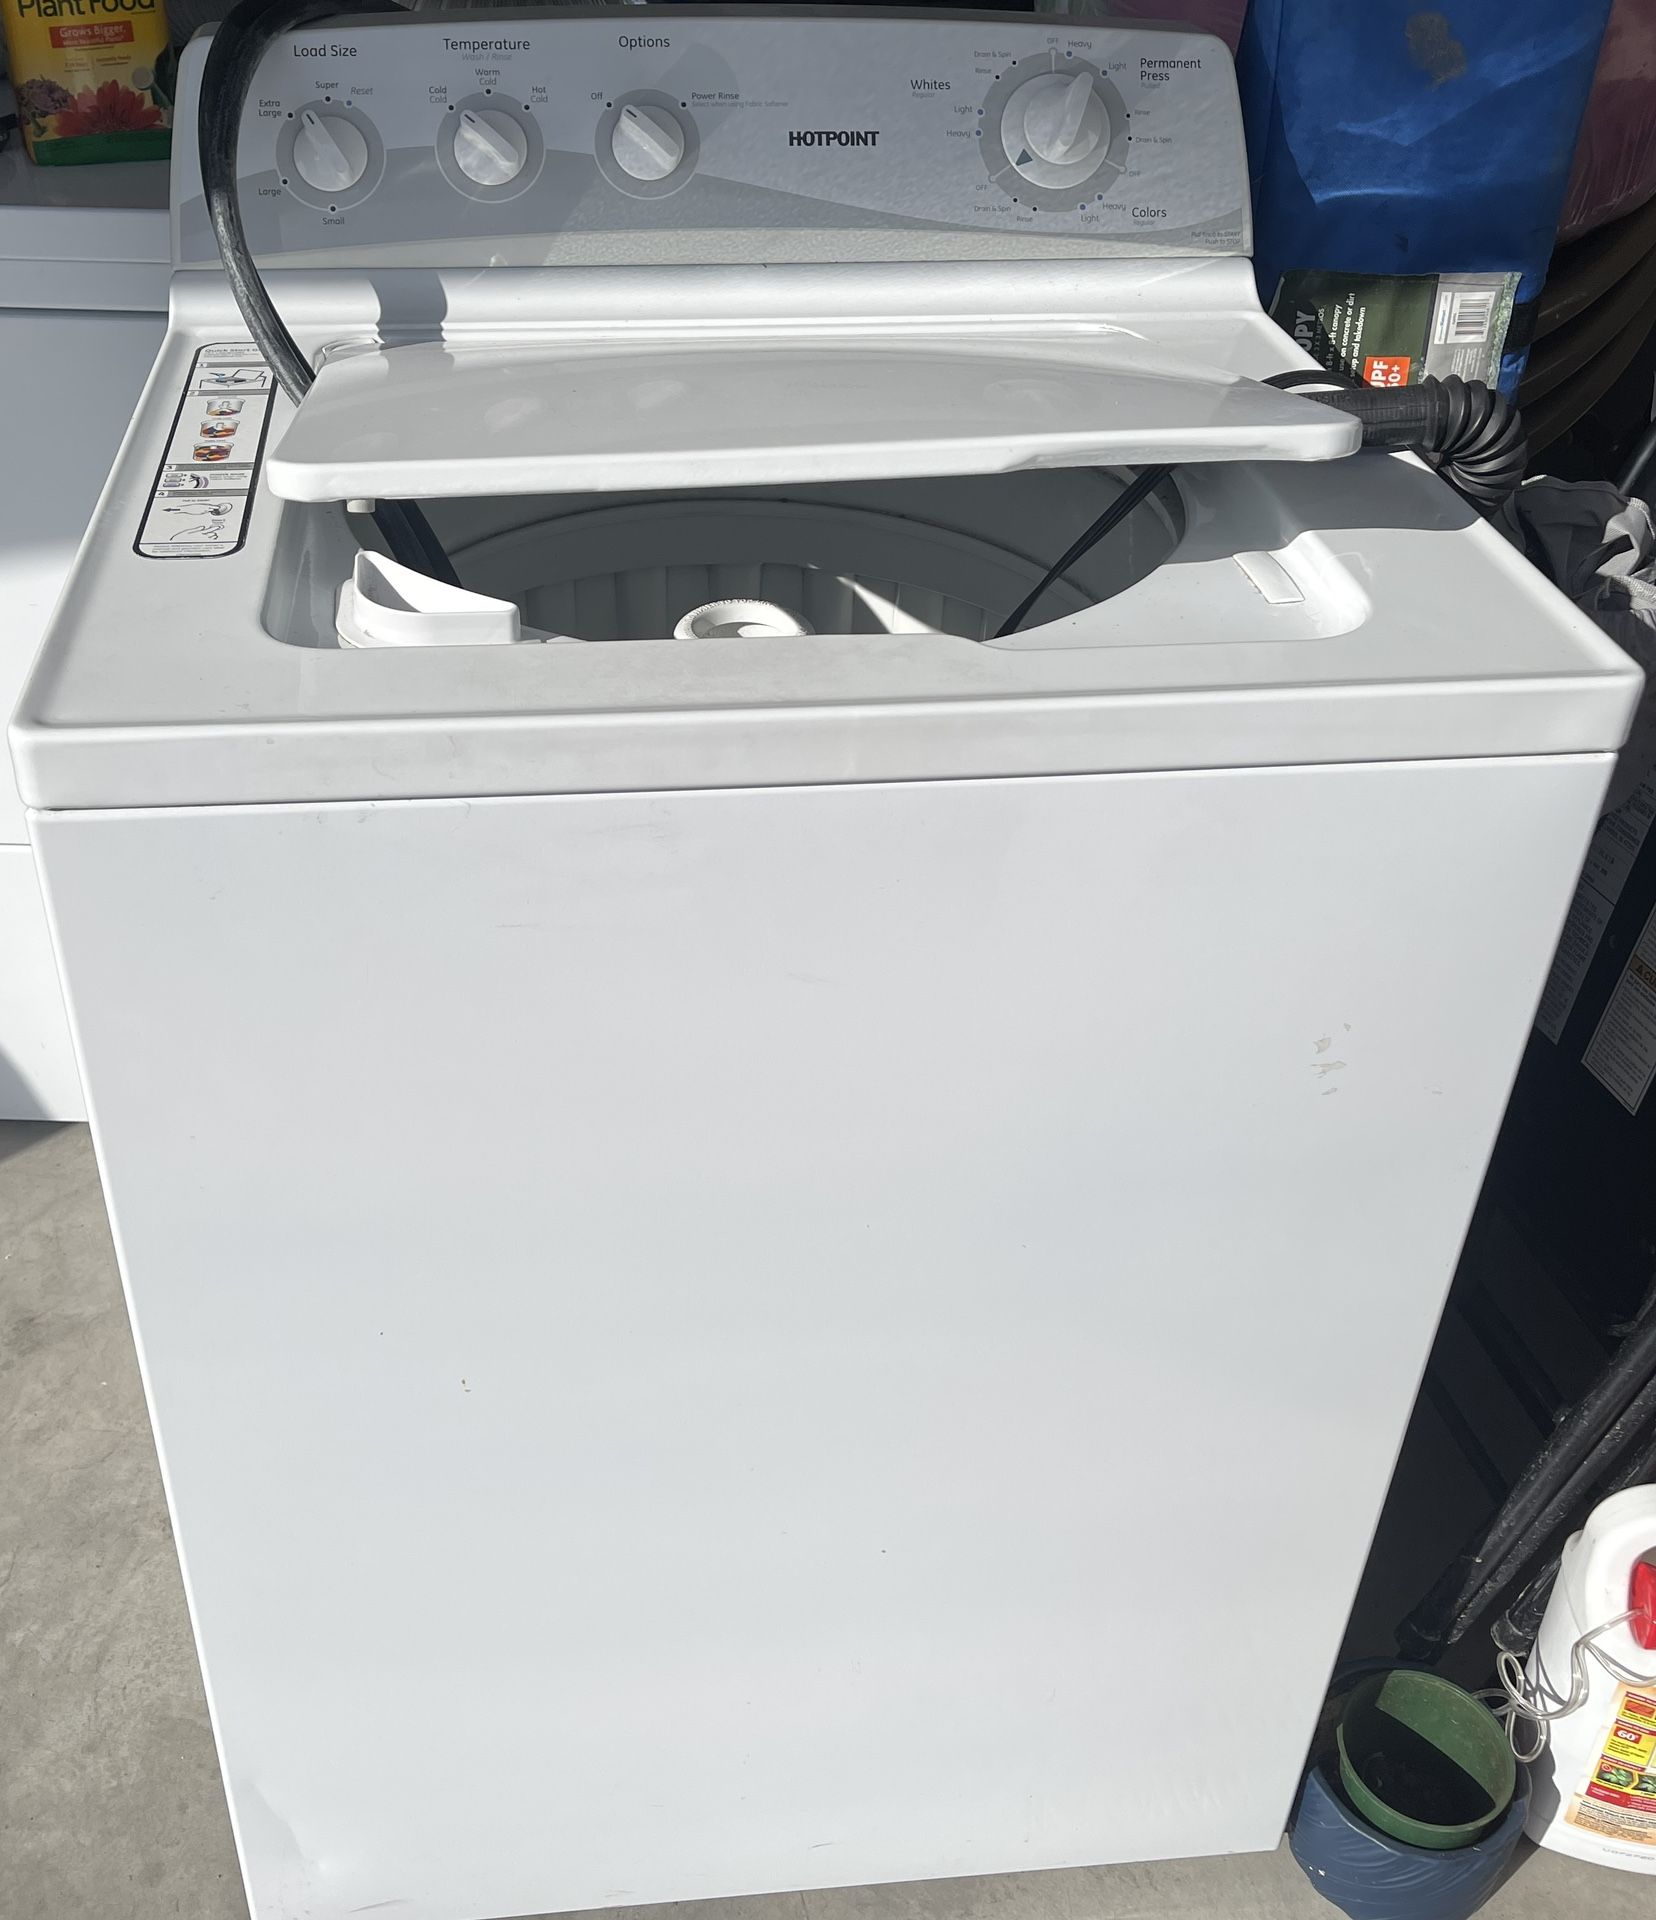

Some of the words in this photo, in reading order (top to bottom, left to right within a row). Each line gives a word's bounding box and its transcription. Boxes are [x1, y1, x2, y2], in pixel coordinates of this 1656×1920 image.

[18, 0, 85, 18] Plant
[59, 26, 91, 38] Grows
[443, 38, 530, 53] Temperature
[618, 35, 671, 50] Options
[1067, 40, 1092, 49] Heavy
[293, 44, 327, 57] Load
[330, 44, 357, 57] Size
[1108, 62, 1127, 72] Light
[1140, 57, 1202, 69] Permanent
[475, 68, 500, 76] Warm
[1140, 70, 1170, 81] Press
[315, 80, 339, 90] Super
[479, 77, 497, 86] Cold
[910, 79, 951, 90] Whites
[350, 86, 373, 95] Reset
[428, 86, 447, 94] Cold
[531, 86, 546, 94] Hot
[429, 95, 448, 104] Cold
[530, 95, 548, 103] Cold
[590, 92, 603, 100] Off
[691, 92, 716, 100] Power
[718, 92, 740, 100] Rinse
[258, 99, 281, 108] Extra
[258, 109, 282, 118] Large
[954, 105, 973, 114] Light
[946, 129, 971, 138] Heavy
[788, 130, 880, 147] HOTPOINT
[258, 188, 282, 197] Large
[1102, 202, 1127, 211] Heavy
[1131, 206, 1167, 218] Colors
[322, 216, 345, 225] Small
[1080, 214, 1099, 223] Light
[1345, 292, 1356, 306] dirt
[1346, 307, 1353, 316] or
[1332, 304, 1343, 332] canopy
[1353, 307, 1366, 342] takedown
[1294, 310, 1316, 353] OPY
[1342, 316, 1352, 346] concrete
[1340, 347, 1347, 358] on
[1351, 342, 1360, 358] and
